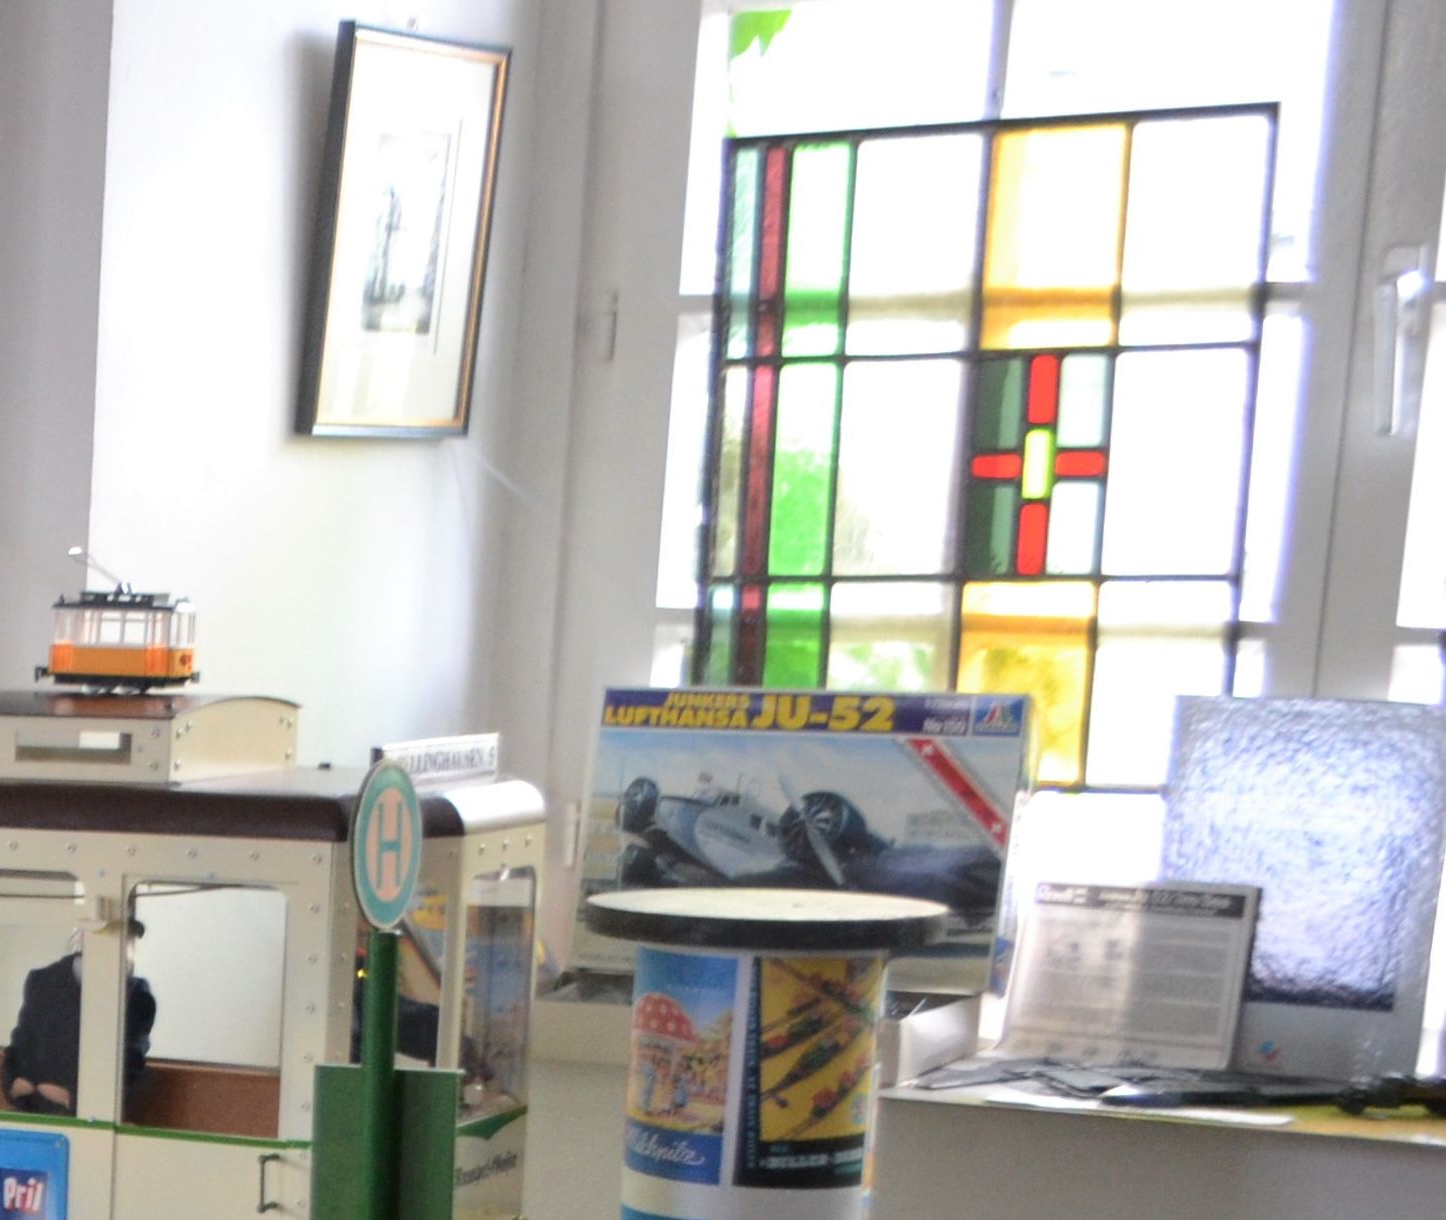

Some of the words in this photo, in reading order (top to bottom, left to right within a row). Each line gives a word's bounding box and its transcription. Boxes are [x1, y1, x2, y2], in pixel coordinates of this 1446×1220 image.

[604, 705, 748, 728] LUFTHANSA
[751, 692, 896, 730] JU-52
[375, 800, 406, 890] H
[4, 1177, 44, 1211] Pril
